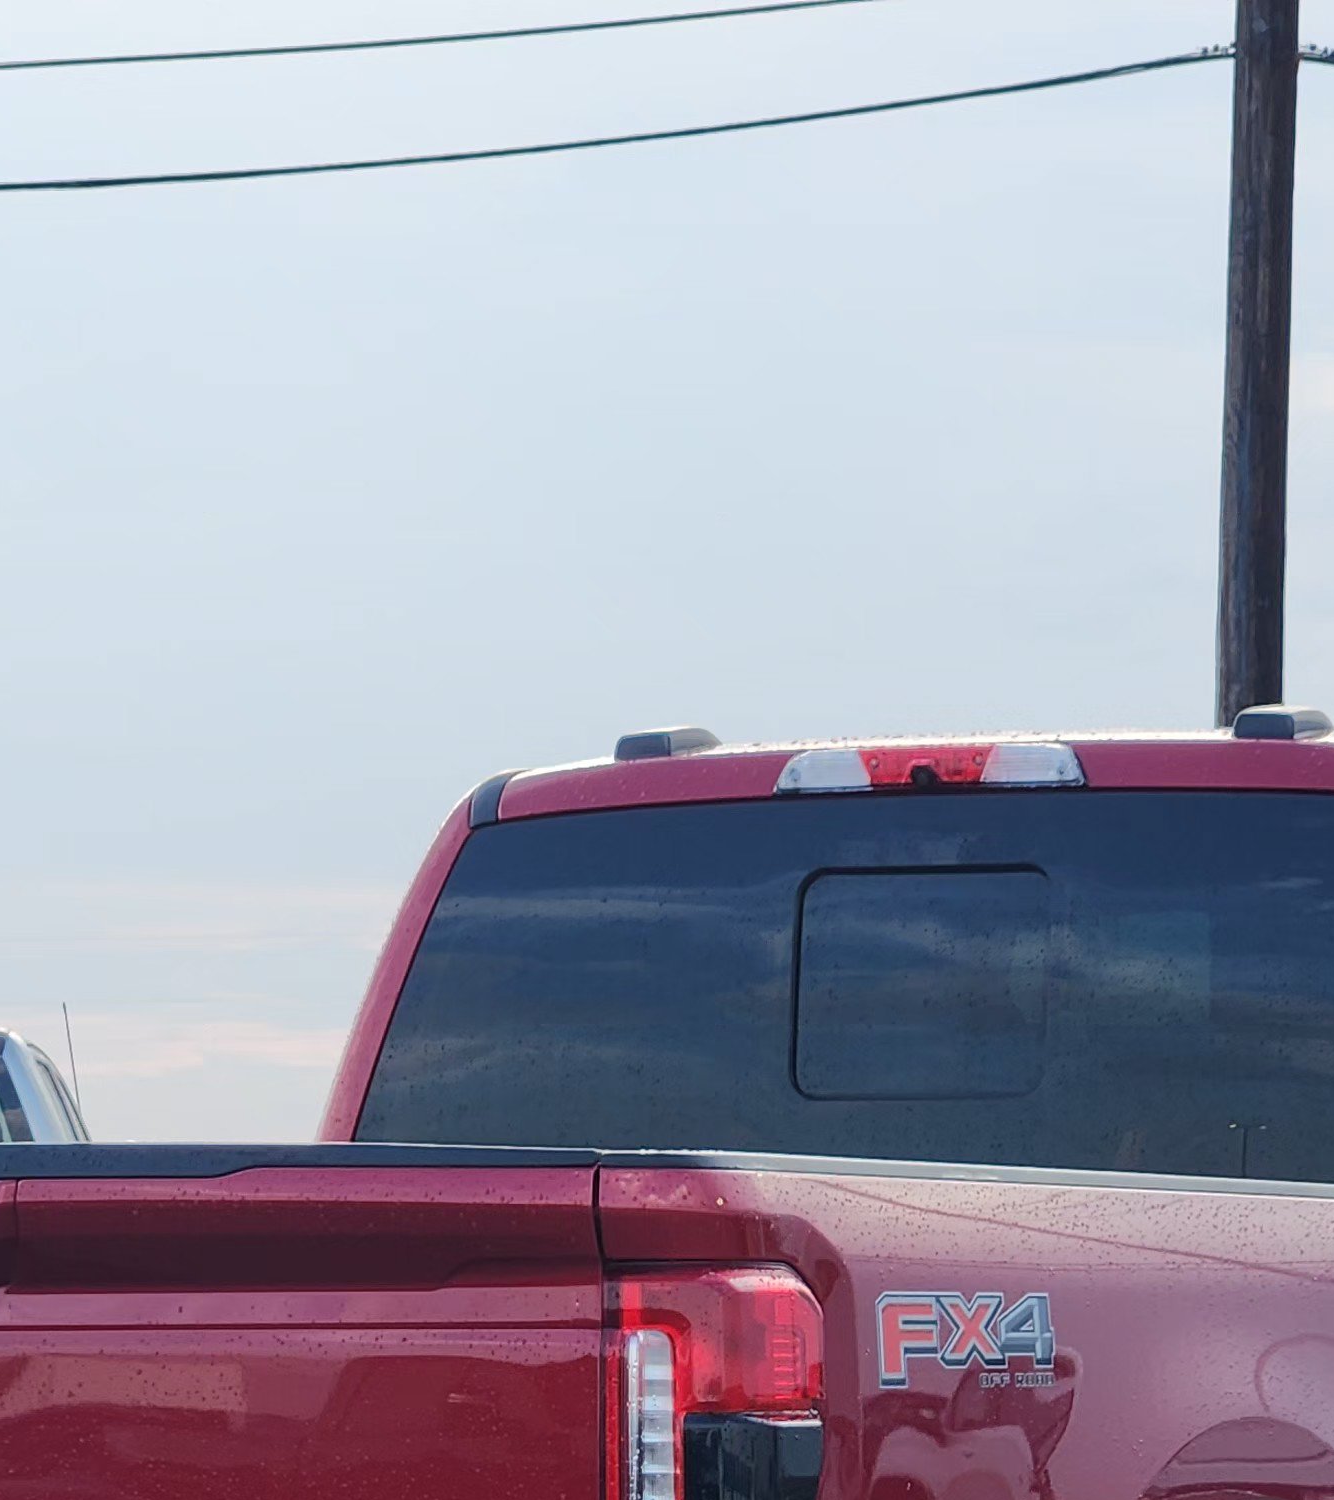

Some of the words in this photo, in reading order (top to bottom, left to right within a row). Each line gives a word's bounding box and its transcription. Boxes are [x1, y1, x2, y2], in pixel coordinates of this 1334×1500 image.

[876, 1292, 1056, 1388] FX4
[978, 1372, 1010, 1388] OFF
[1014, 1372, 1055, 1388] ROAD
